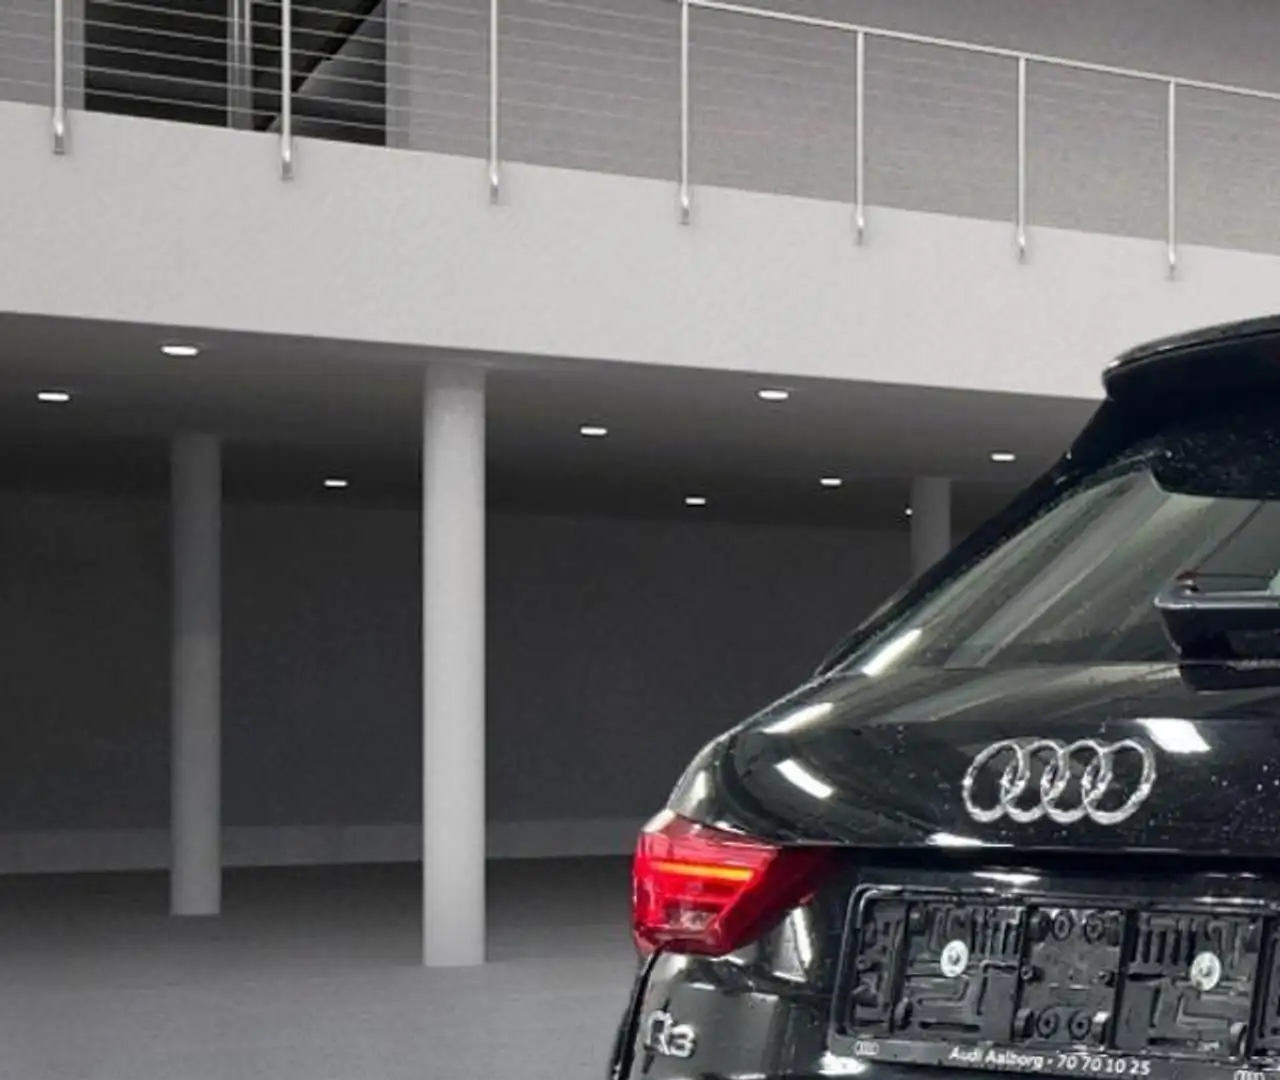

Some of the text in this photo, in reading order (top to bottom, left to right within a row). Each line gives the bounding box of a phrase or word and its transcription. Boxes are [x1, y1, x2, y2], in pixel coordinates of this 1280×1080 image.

[646, 1010, 695, 1058] Q3
[950, 1047, 982, 1063] Audi
[985, 1049, 1044, 1070] Aalborg
[1057, 1054, 1077, 1069] 70
[1081, 1056, 1101, 1072] 70
[1105, 1058, 1126, 1073] 10
[1129, 1060, 1151, 1076] 25
